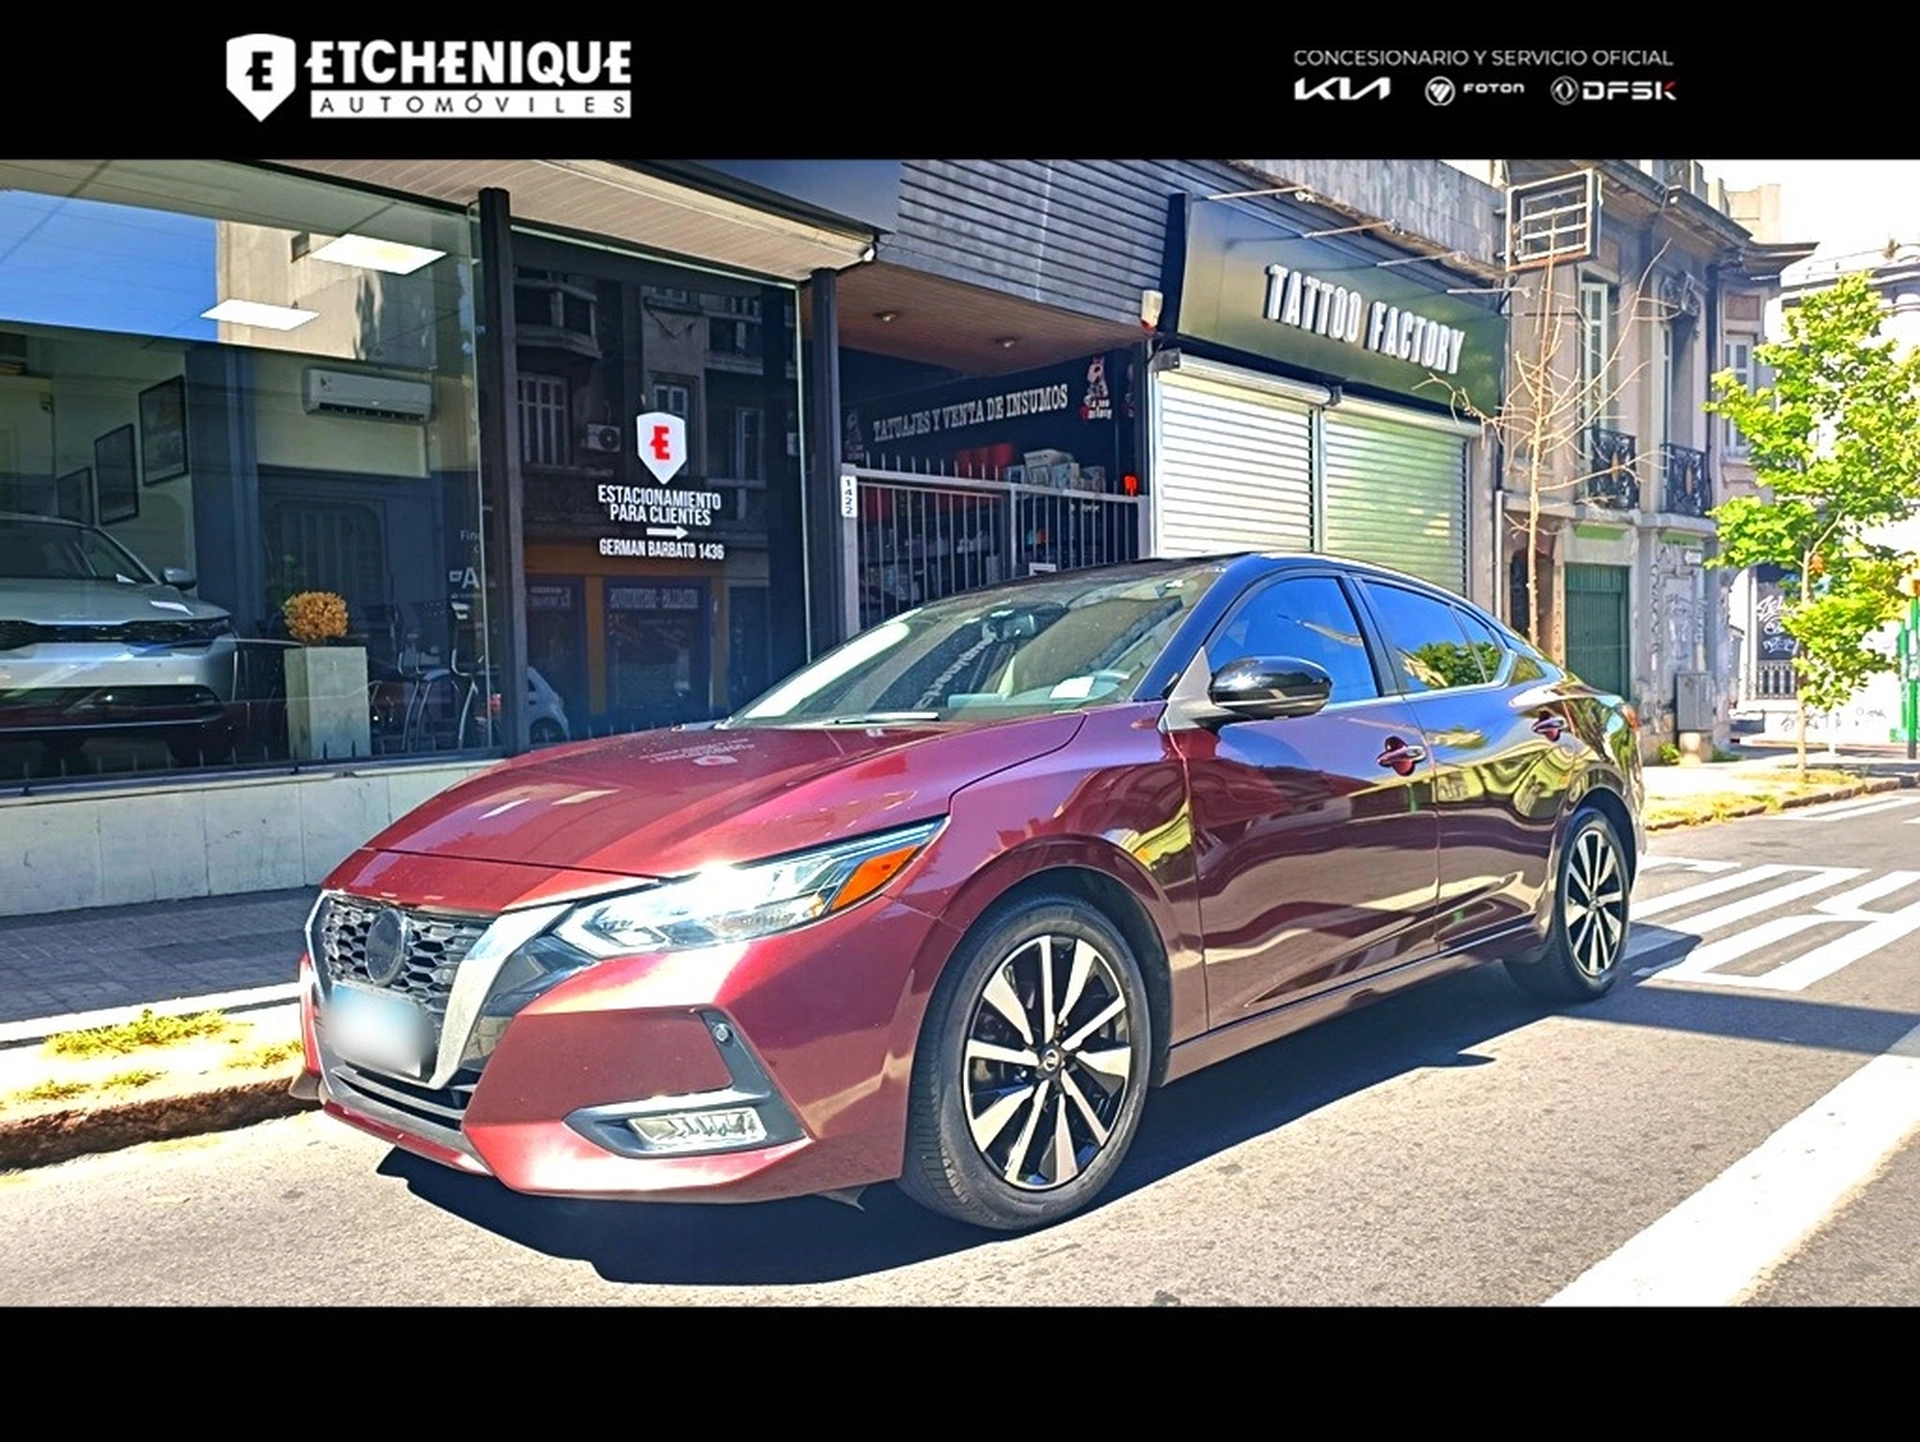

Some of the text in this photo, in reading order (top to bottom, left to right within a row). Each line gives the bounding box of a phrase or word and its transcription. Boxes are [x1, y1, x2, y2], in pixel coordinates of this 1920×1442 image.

[1264, 264, 1465, 375] TATTOO FACTORY
[873, 415, 931, 441] TATUAJES
[934, 411, 942, 432] Y
[943, 402, 984, 429] VENTA
[986, 396, 1005, 420] DE
[1005, 384, 1069, 418] INSUMOS
[598, 484, 721, 510] ESTACIONAMIENTO
[610, 503, 711, 526] PARA CLIENTES
[599, 538, 725, 560] GERMAN BARBATO 1436
